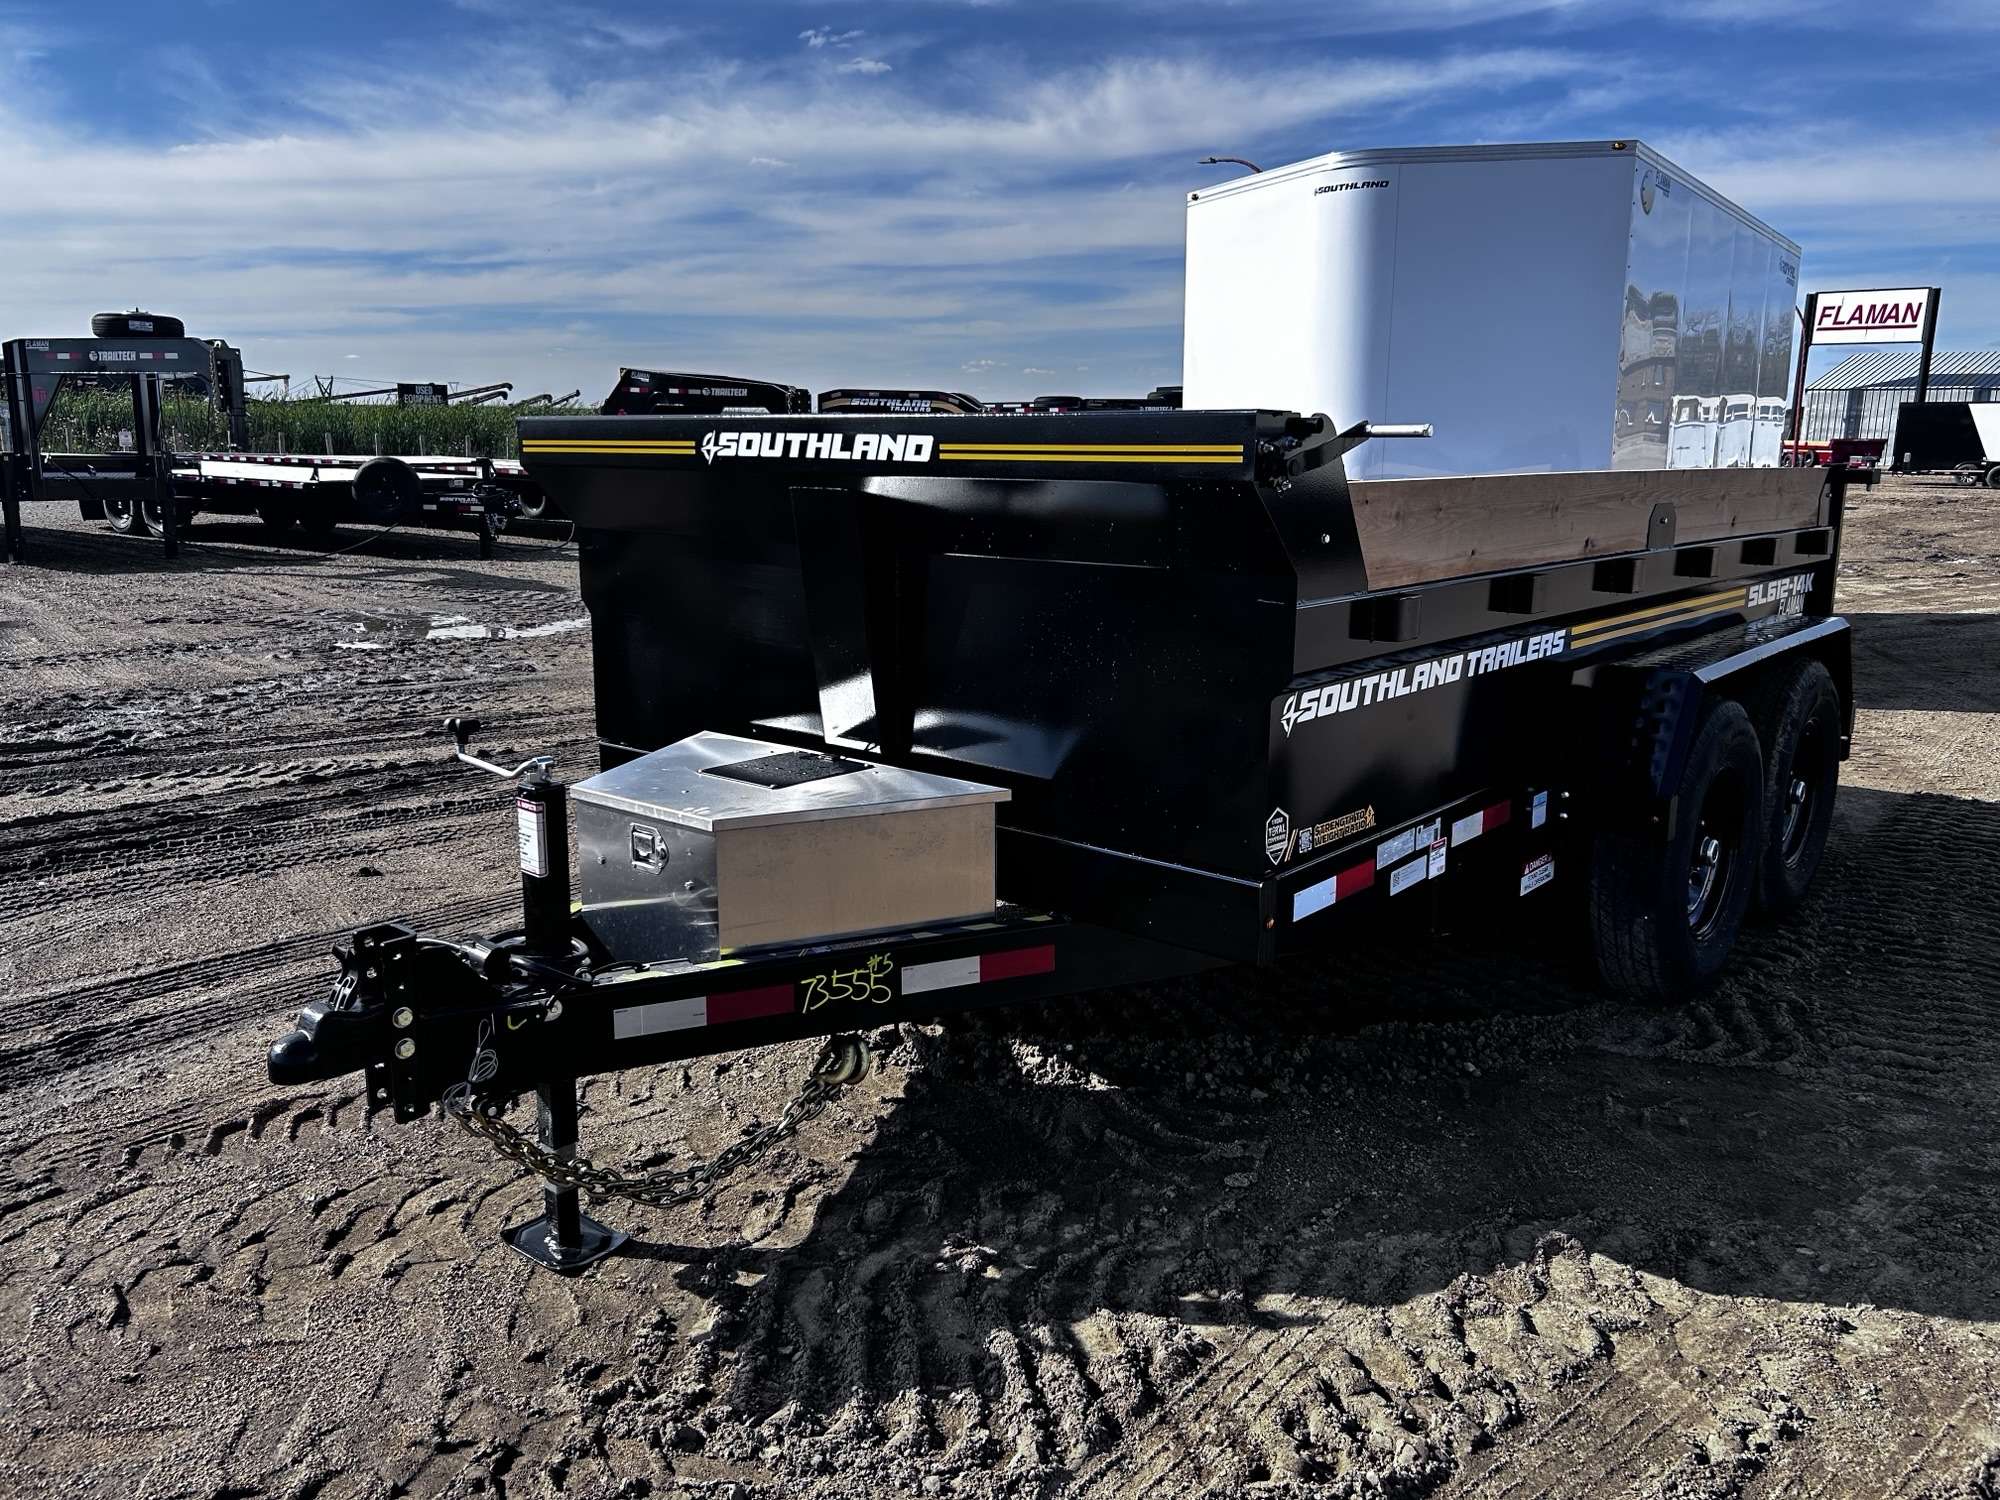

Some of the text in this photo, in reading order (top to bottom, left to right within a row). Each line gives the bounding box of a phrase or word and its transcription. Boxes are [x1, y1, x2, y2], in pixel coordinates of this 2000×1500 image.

[1318, 180, 1390, 194] SOUTHLAND
[1817, 302, 1923, 326] FLAMAN
[98, 351, 136, 361] TRAILTECH
[415, 385, 433, 394] USED
[711, 387, 748, 397] TRAILTECH
[850, 399, 932, 408] SOUTHLAND
[717, 431, 934, 463] SOUTHLAND
[1747, 572, 1816, 608] SL612-14K
[1296, 629, 1567, 724] SOUTHLAND TRAILERS
[1314, 812, 1354, 835] STRENGTH
[1314, 820, 1366, 846] WEIGHT RATIO
